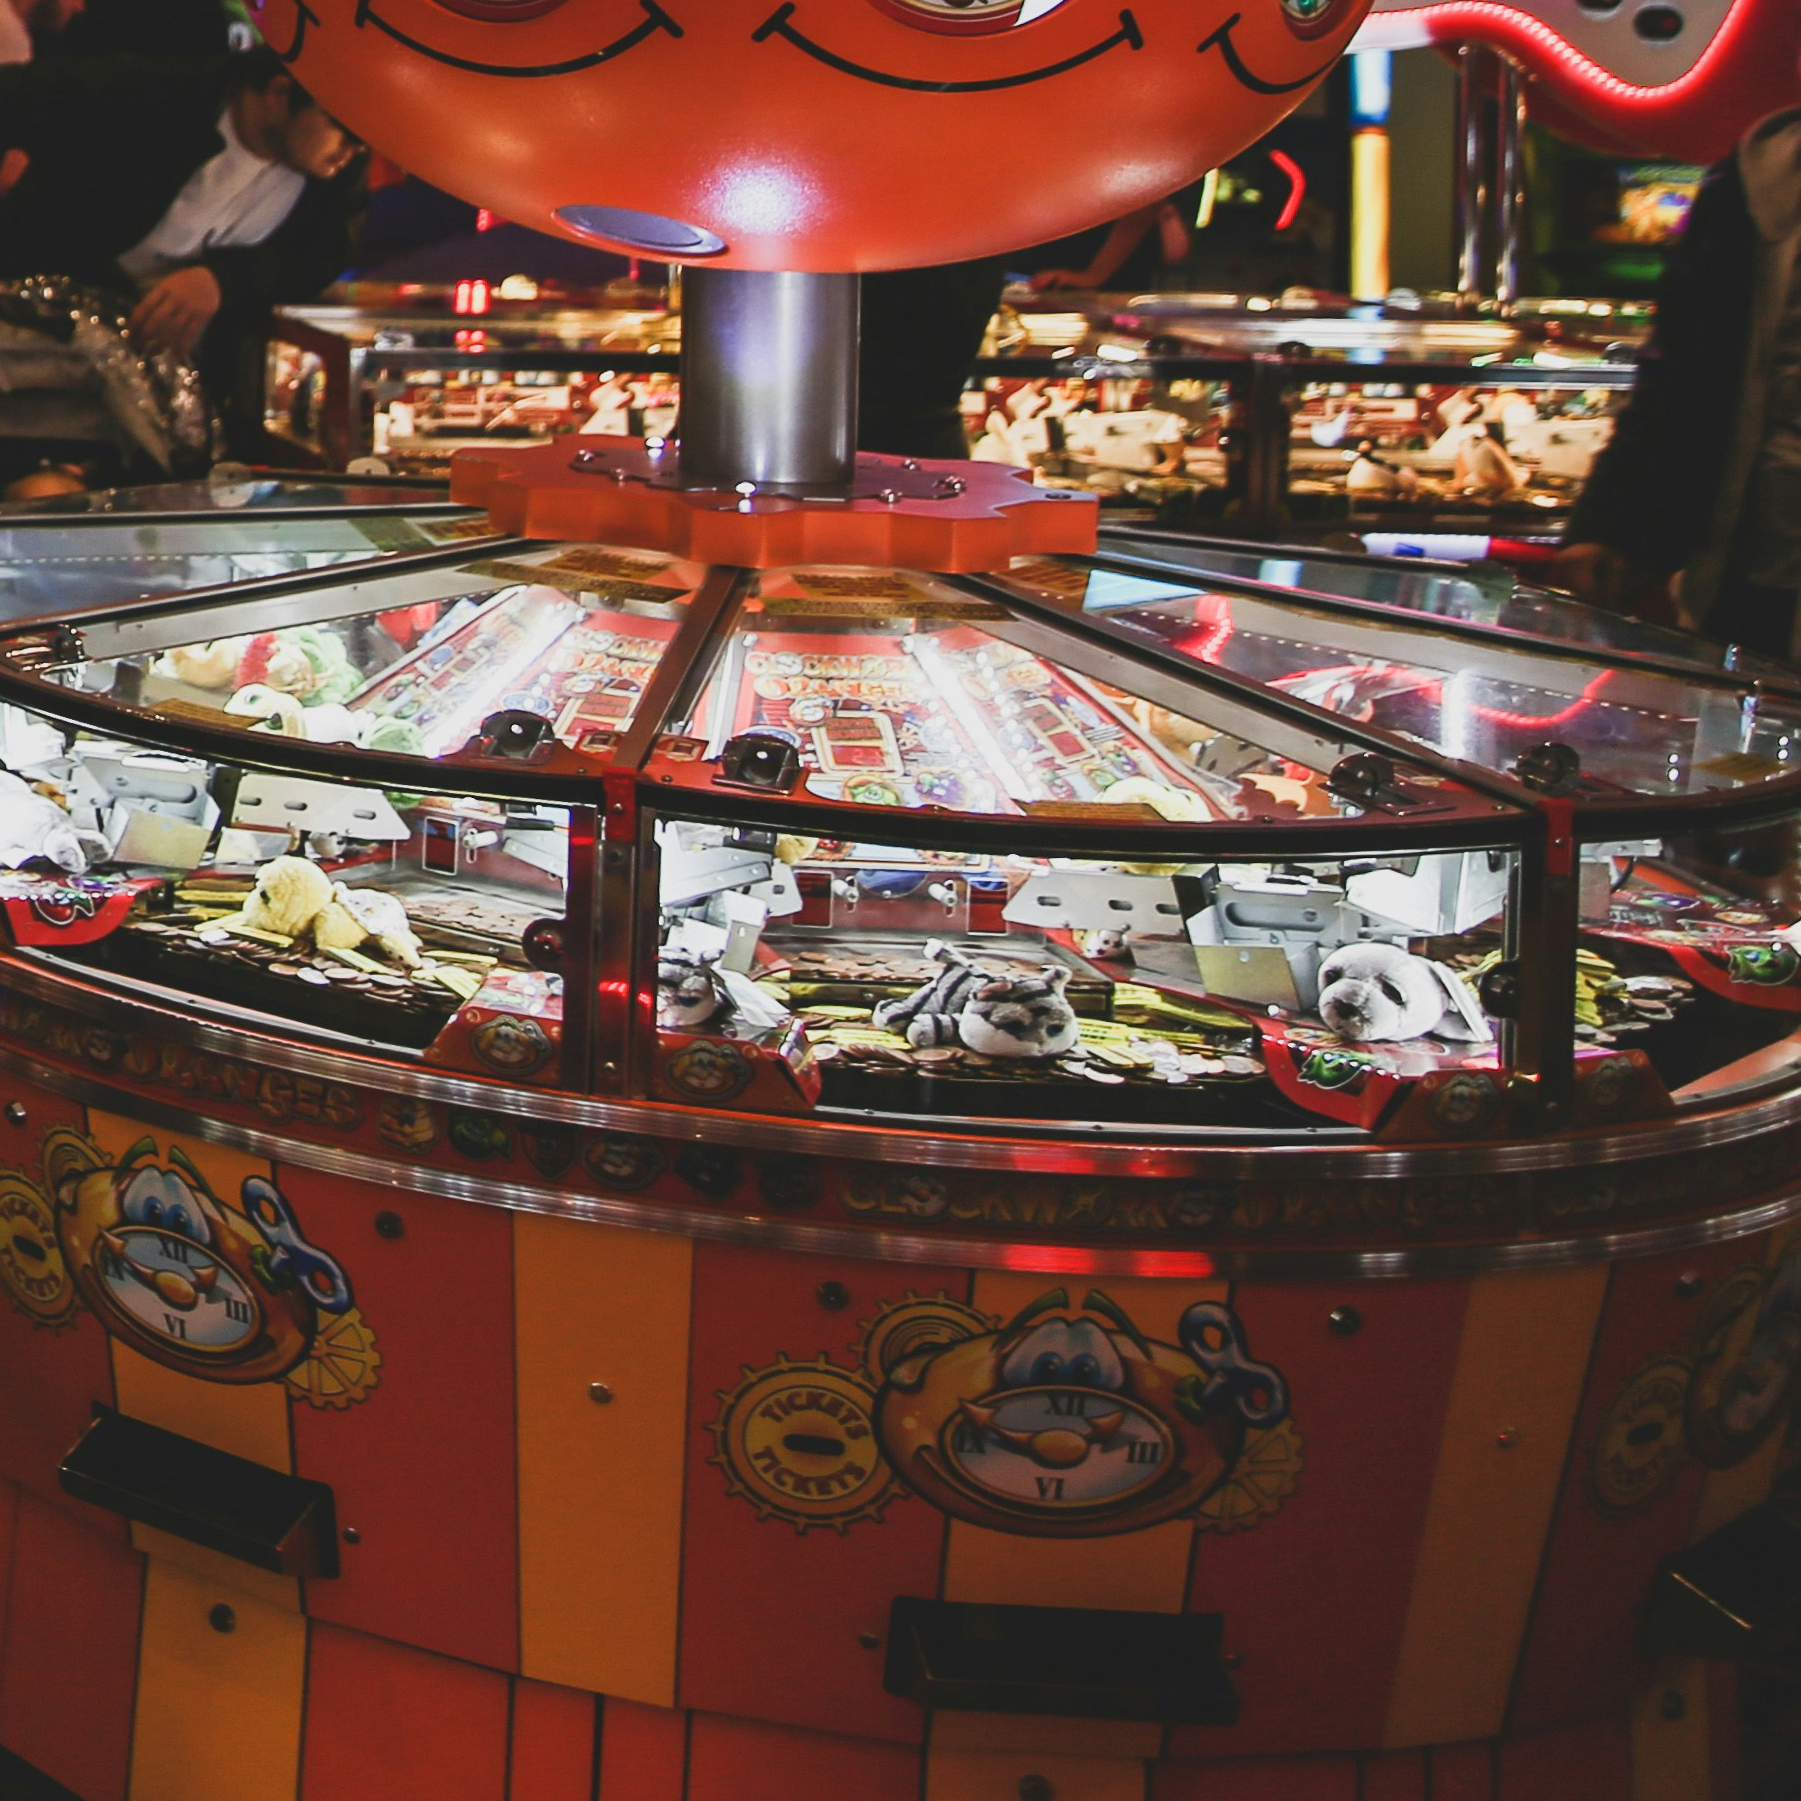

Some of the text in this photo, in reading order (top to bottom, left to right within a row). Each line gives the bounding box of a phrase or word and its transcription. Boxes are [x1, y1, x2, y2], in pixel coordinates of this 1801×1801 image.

[758, 1389, 871, 1441] TICKETS
[751, 1444, 868, 1496] TICKETS
[1125, 1440, 1162, 1465] III
[1033, 1476, 1066, 1501] VI
